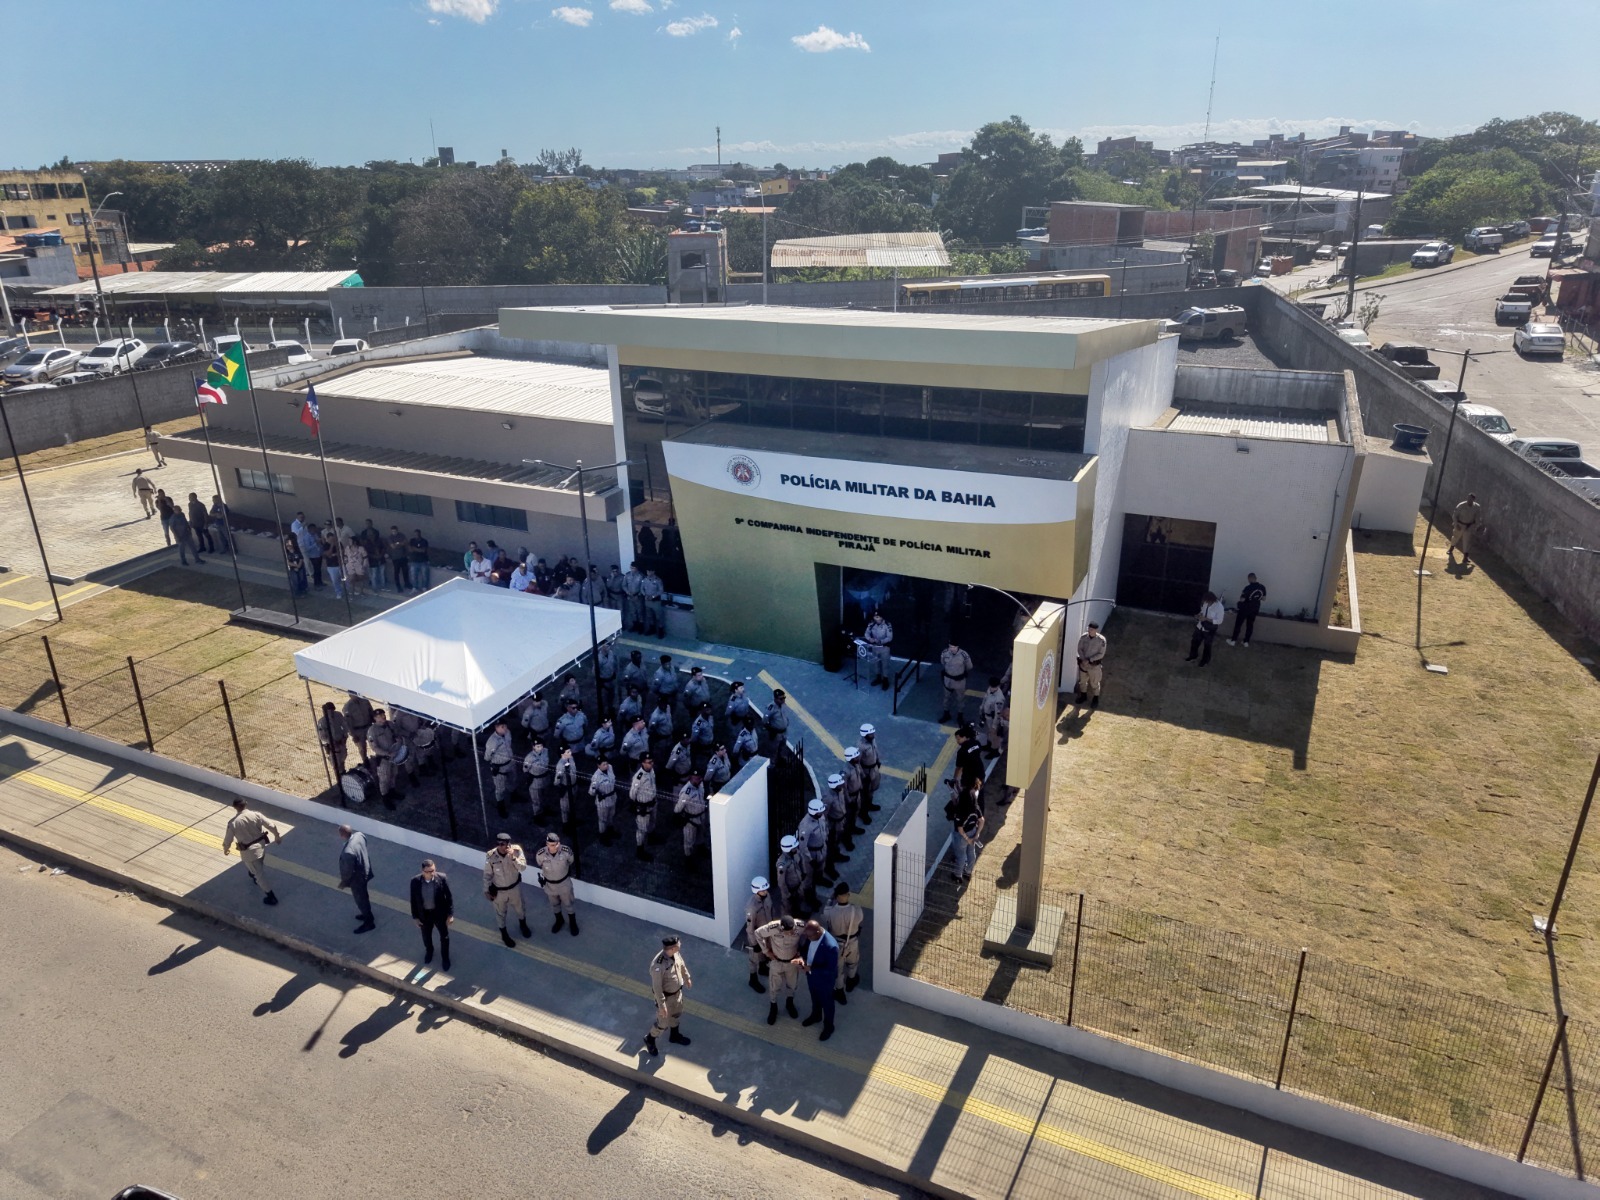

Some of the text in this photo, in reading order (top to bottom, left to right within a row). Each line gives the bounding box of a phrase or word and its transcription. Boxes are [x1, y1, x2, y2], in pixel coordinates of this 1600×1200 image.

[780, 473, 996, 508] POLÍCIA MILITAR DA BAHIA
[747, 519, 804, 534] COMPANHIA
[805, 527, 881, 545] INDEPENDENTE
[882, 537, 897, 547] DE
[899, 540, 943, 552] POLÍCIA
[945, 545, 991, 559] MILITAR
[838, 540, 876, 553] PIRAJÁ
